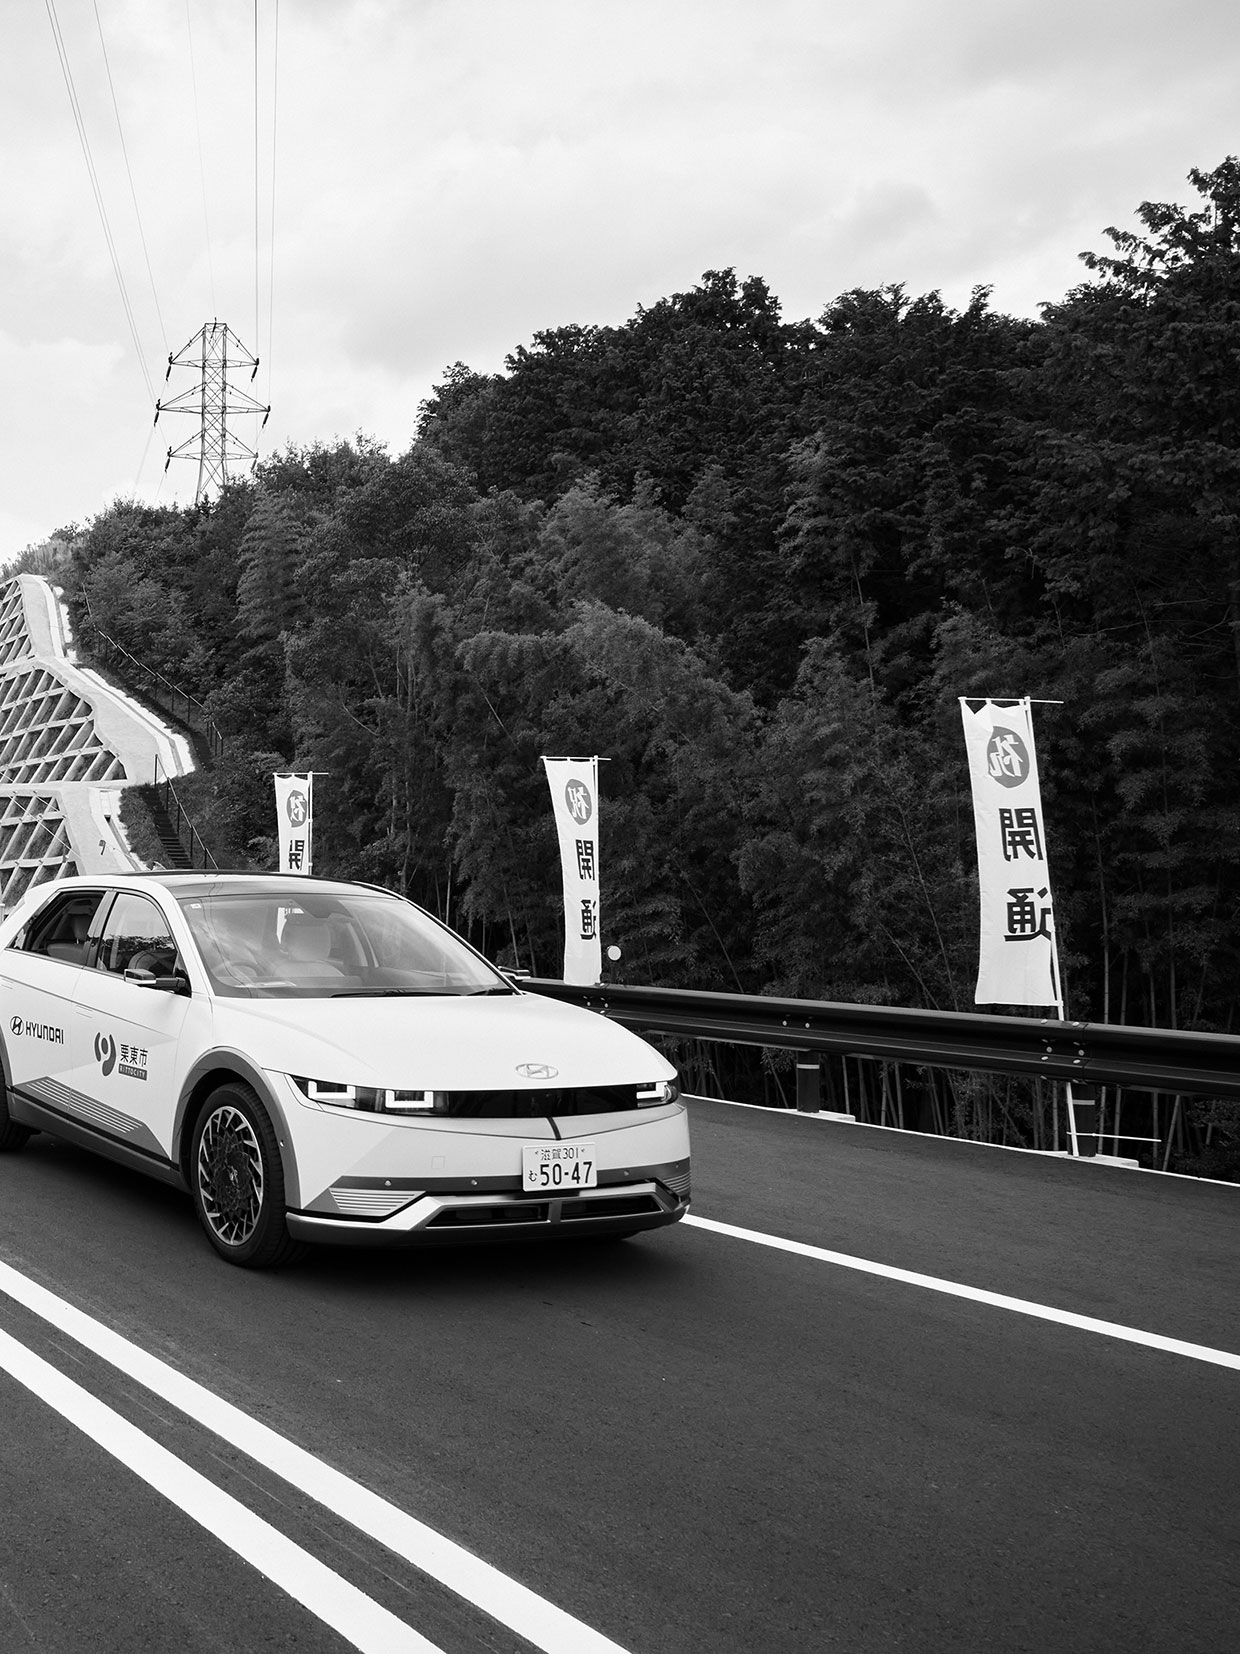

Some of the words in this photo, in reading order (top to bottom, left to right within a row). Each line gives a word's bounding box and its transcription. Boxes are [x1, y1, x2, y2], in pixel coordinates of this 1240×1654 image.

[25, 1020, 64, 1045] HYUNDAI
[120, 1043, 148, 1067] 栗東市
[540, 1161, 593, 1187] 50-47
